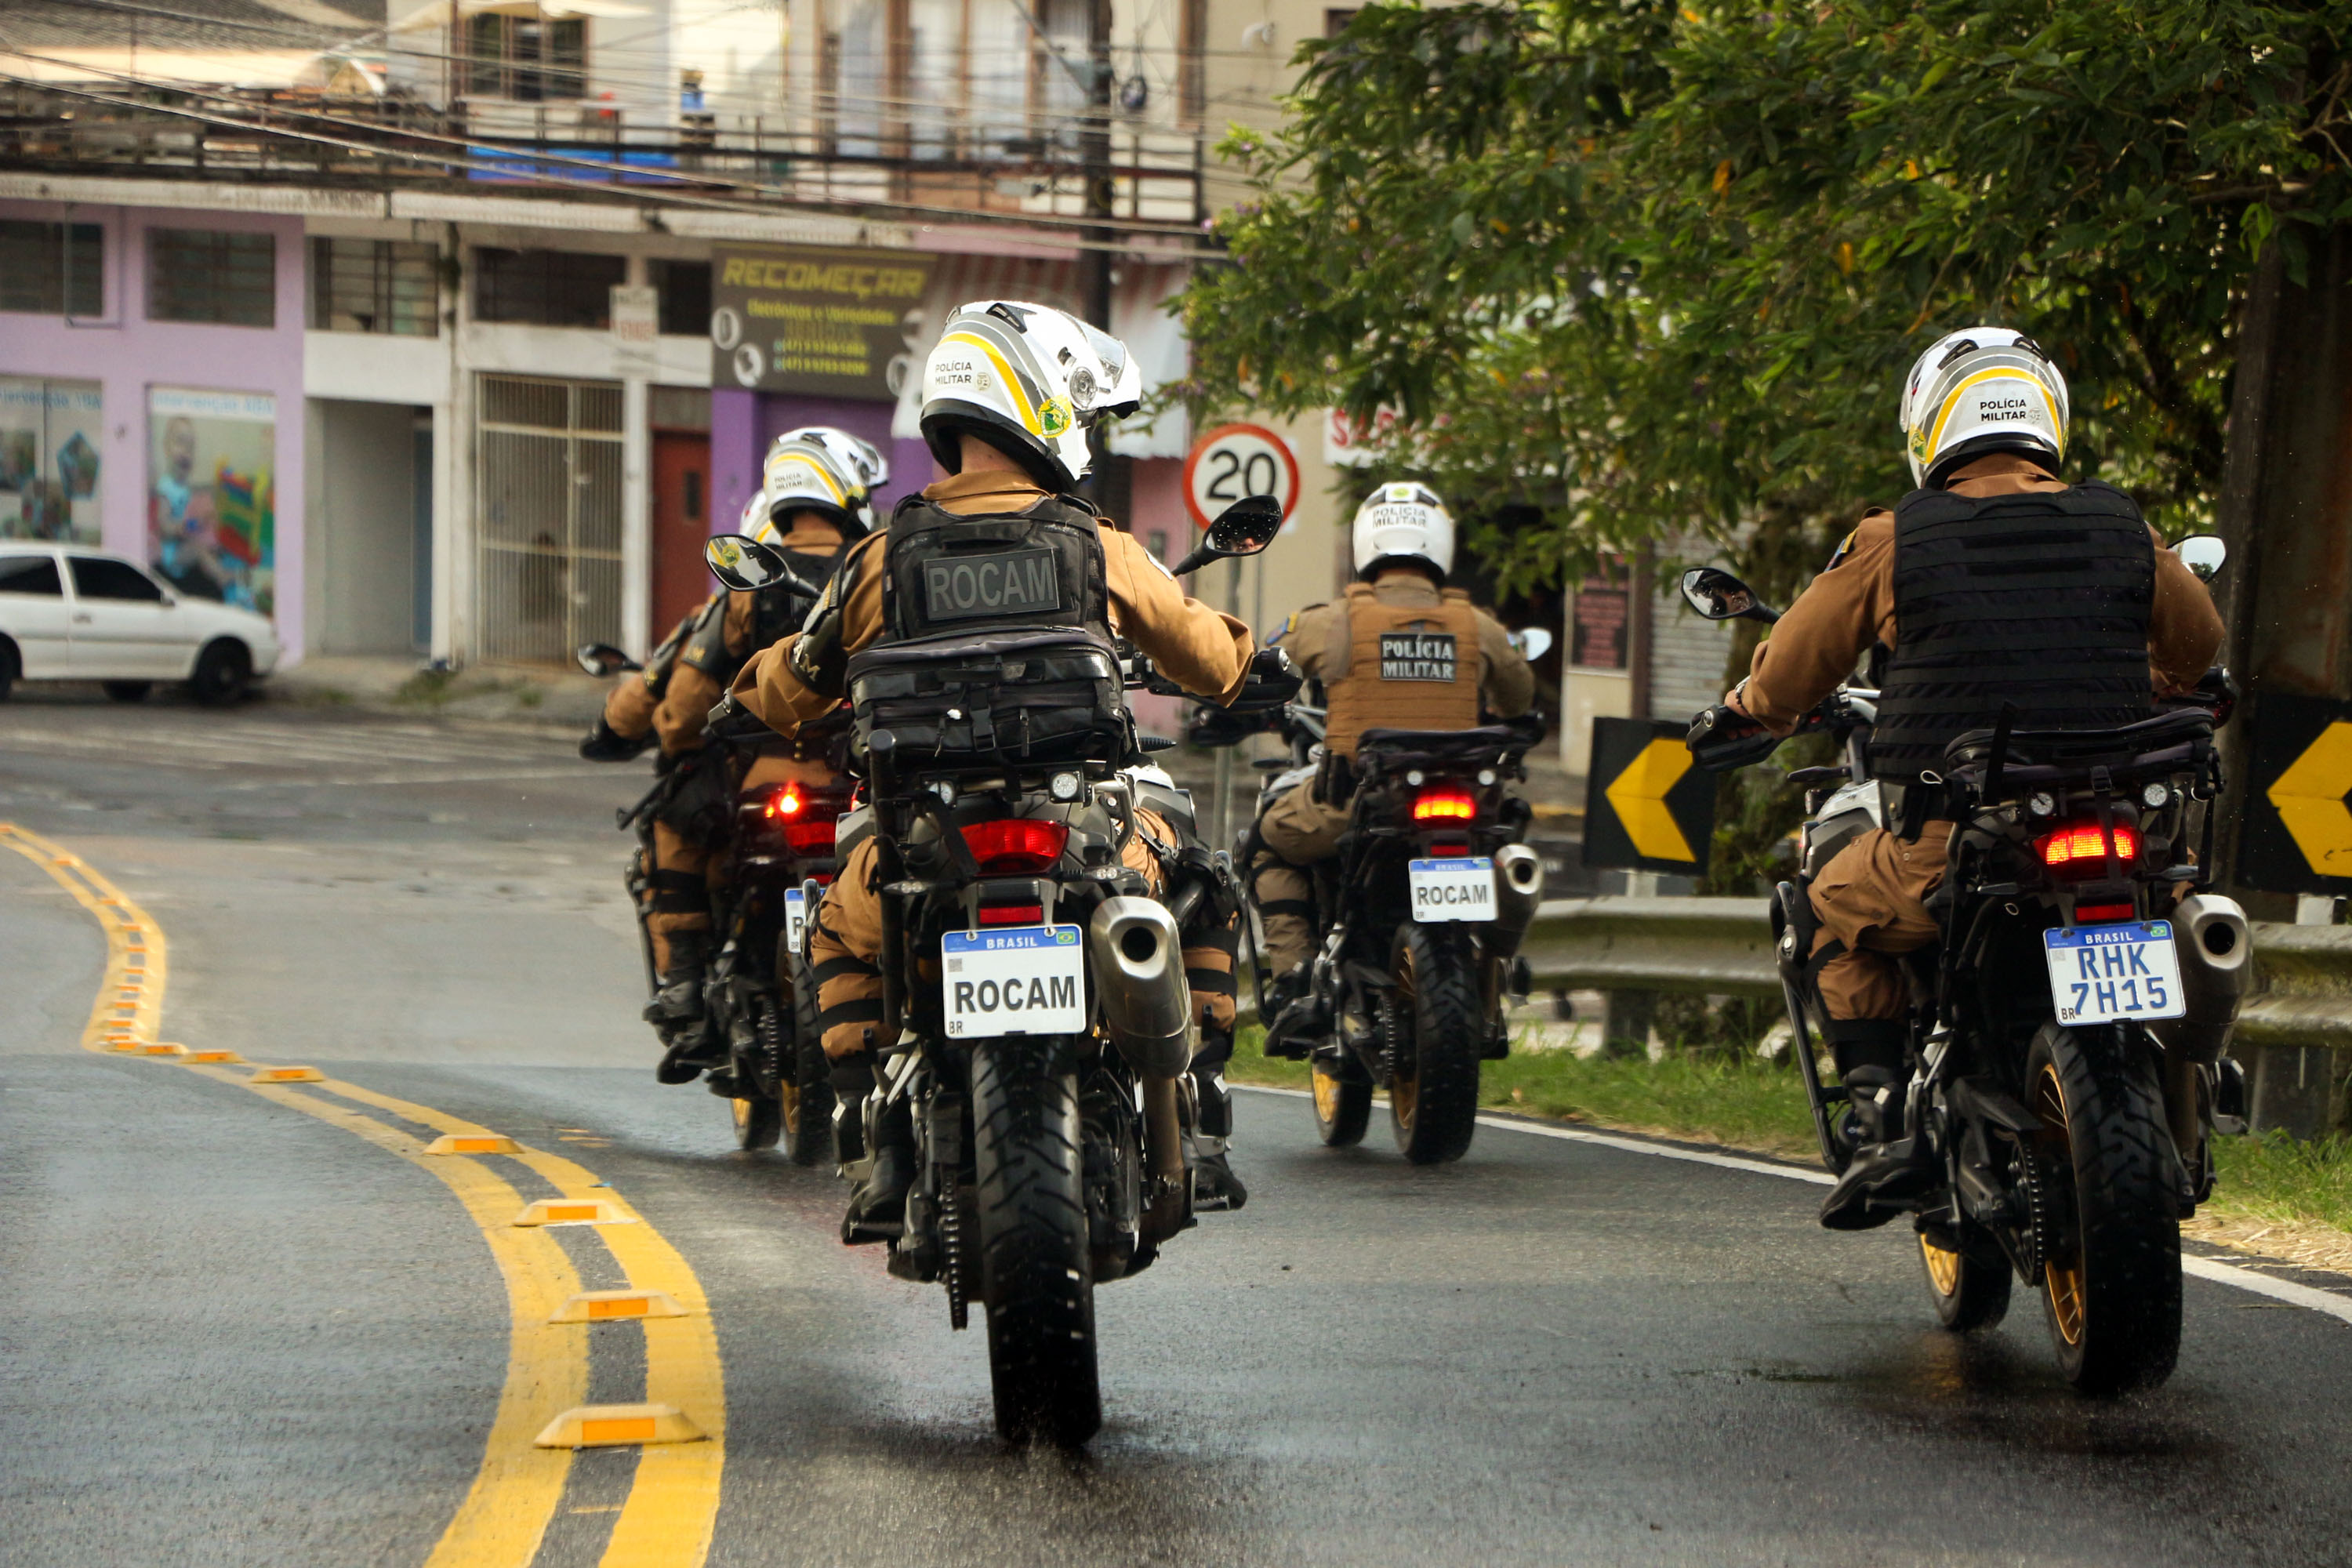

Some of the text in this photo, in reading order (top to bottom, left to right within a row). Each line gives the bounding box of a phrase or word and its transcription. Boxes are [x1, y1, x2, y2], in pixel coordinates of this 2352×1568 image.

[722, 257, 927, 301] RECOMEÇAR
[935, 361, 972, 372] POLÍCIA
[935, 375, 972, 385] MILITAR
[1980, 398, 2027, 410] POLÍCIA
[1981, 411, 2026, 422] MILITAR
[775, 472, 802, 483] POLÍCIA
[1207, 449, 1276, 500] 20
[776, 480, 802, 490] MILITAR
[1373, 504, 1426, 517] POLÍCIA
[1373, 517, 1426, 528] MILITAR
[928, 557, 1054, 612] ROCAM
[1382, 633, 1454, 659] POLÍCIA
[1382, 662, 1453, 679] MILITAR
[1417, 884, 1488, 906] ROCAM
[986, 937, 1037, 949] BRASIL
[2085, 932, 2132, 944] BRASIL
[2077, 944, 2151, 980] RHK
[954, 976, 1076, 1014] ROCAM
[2071, 977, 2167, 1015] 7H15
[2061, 1007, 2075, 1020] BR
[949, 1021, 963, 1034] BR
